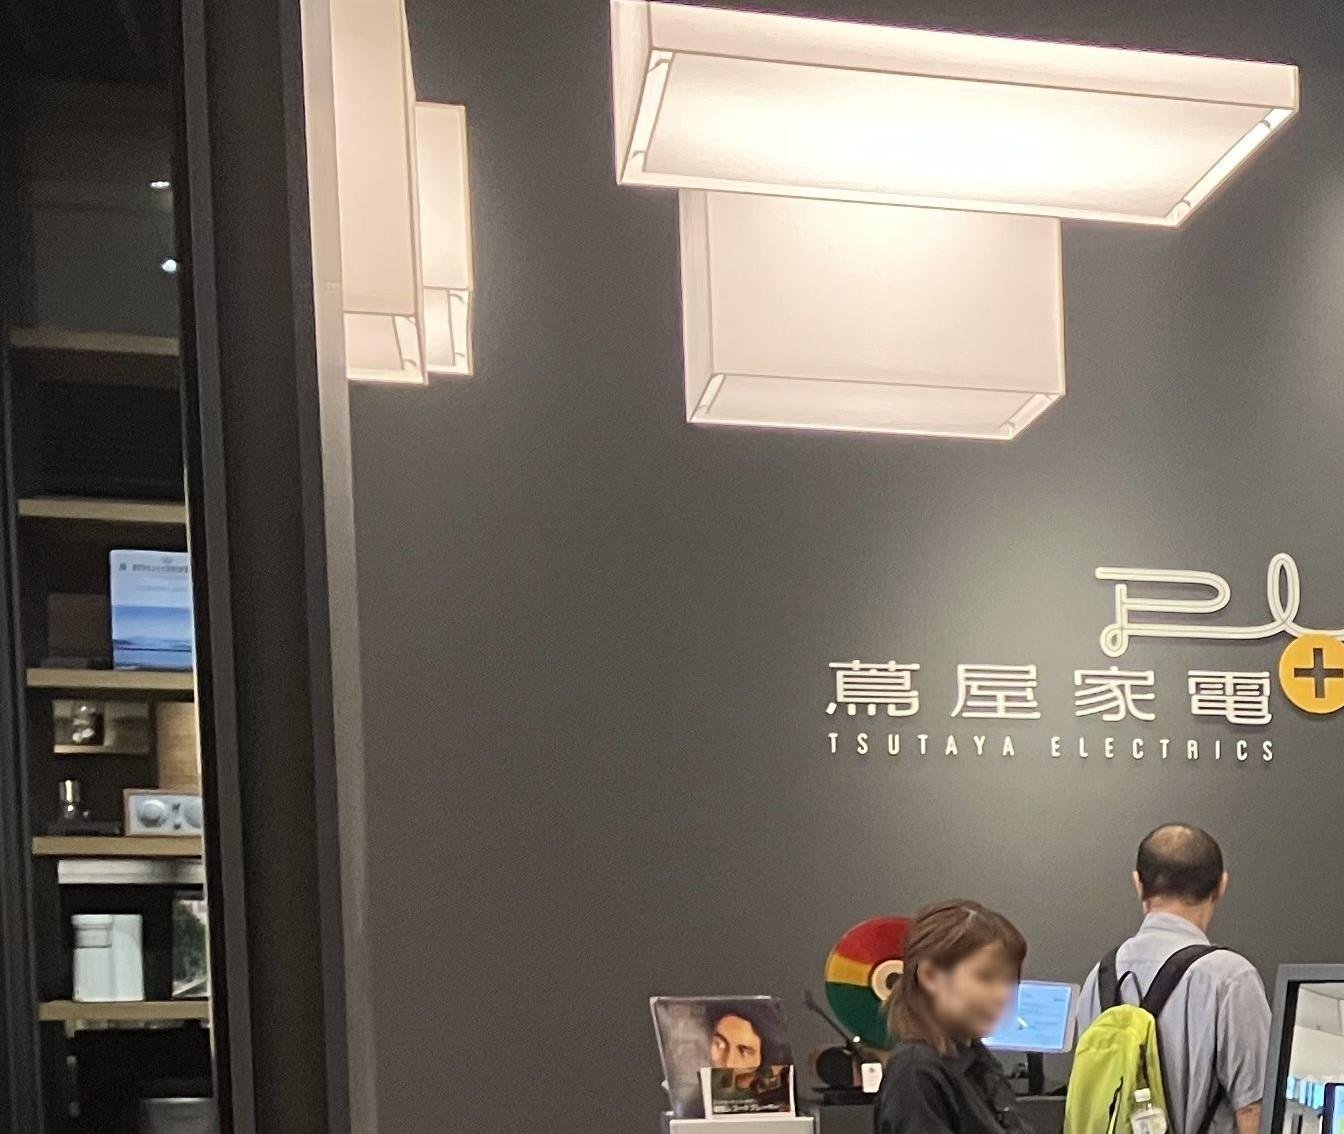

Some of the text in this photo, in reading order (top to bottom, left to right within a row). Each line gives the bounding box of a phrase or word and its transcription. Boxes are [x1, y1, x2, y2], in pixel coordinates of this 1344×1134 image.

[826, 660, 1272, 725] 蔦屋家電
[828, 732, 1275, 763] TSUTAYA ELECTRICS
